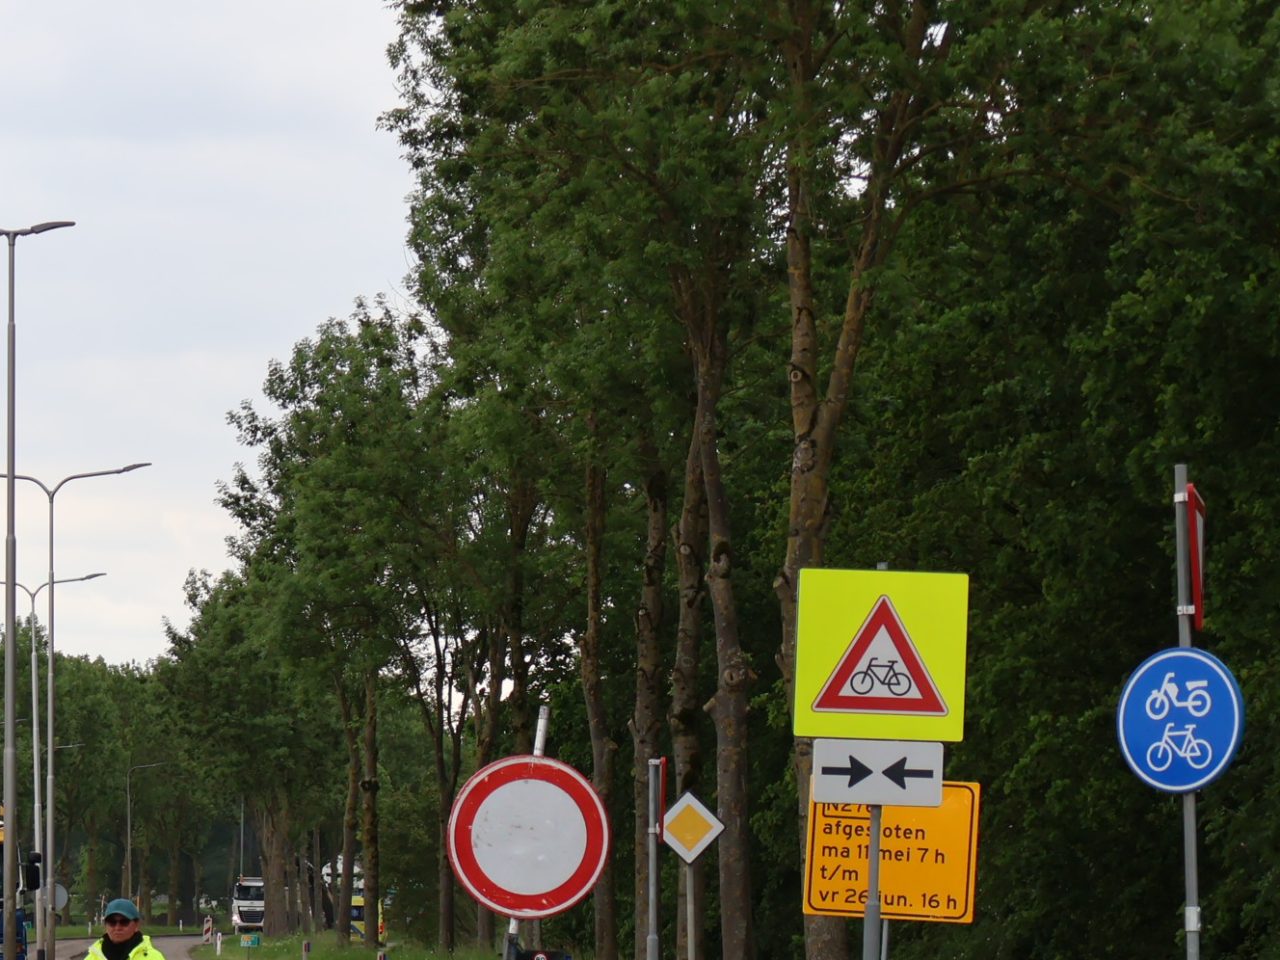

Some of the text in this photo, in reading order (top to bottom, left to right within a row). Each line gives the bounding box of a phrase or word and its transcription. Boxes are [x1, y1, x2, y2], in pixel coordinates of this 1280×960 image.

[821, 845, 850, 858] ma
[879, 847, 911, 862] mei
[917, 848, 929, 863] 7
[934, 848, 945, 864] h
[820, 864, 859, 881] t/m
[819, 890, 839, 902] vr
[844, 888, 869, 904] 26
[921, 893, 940, 909] 16
[946, 895, 957, 910] h
